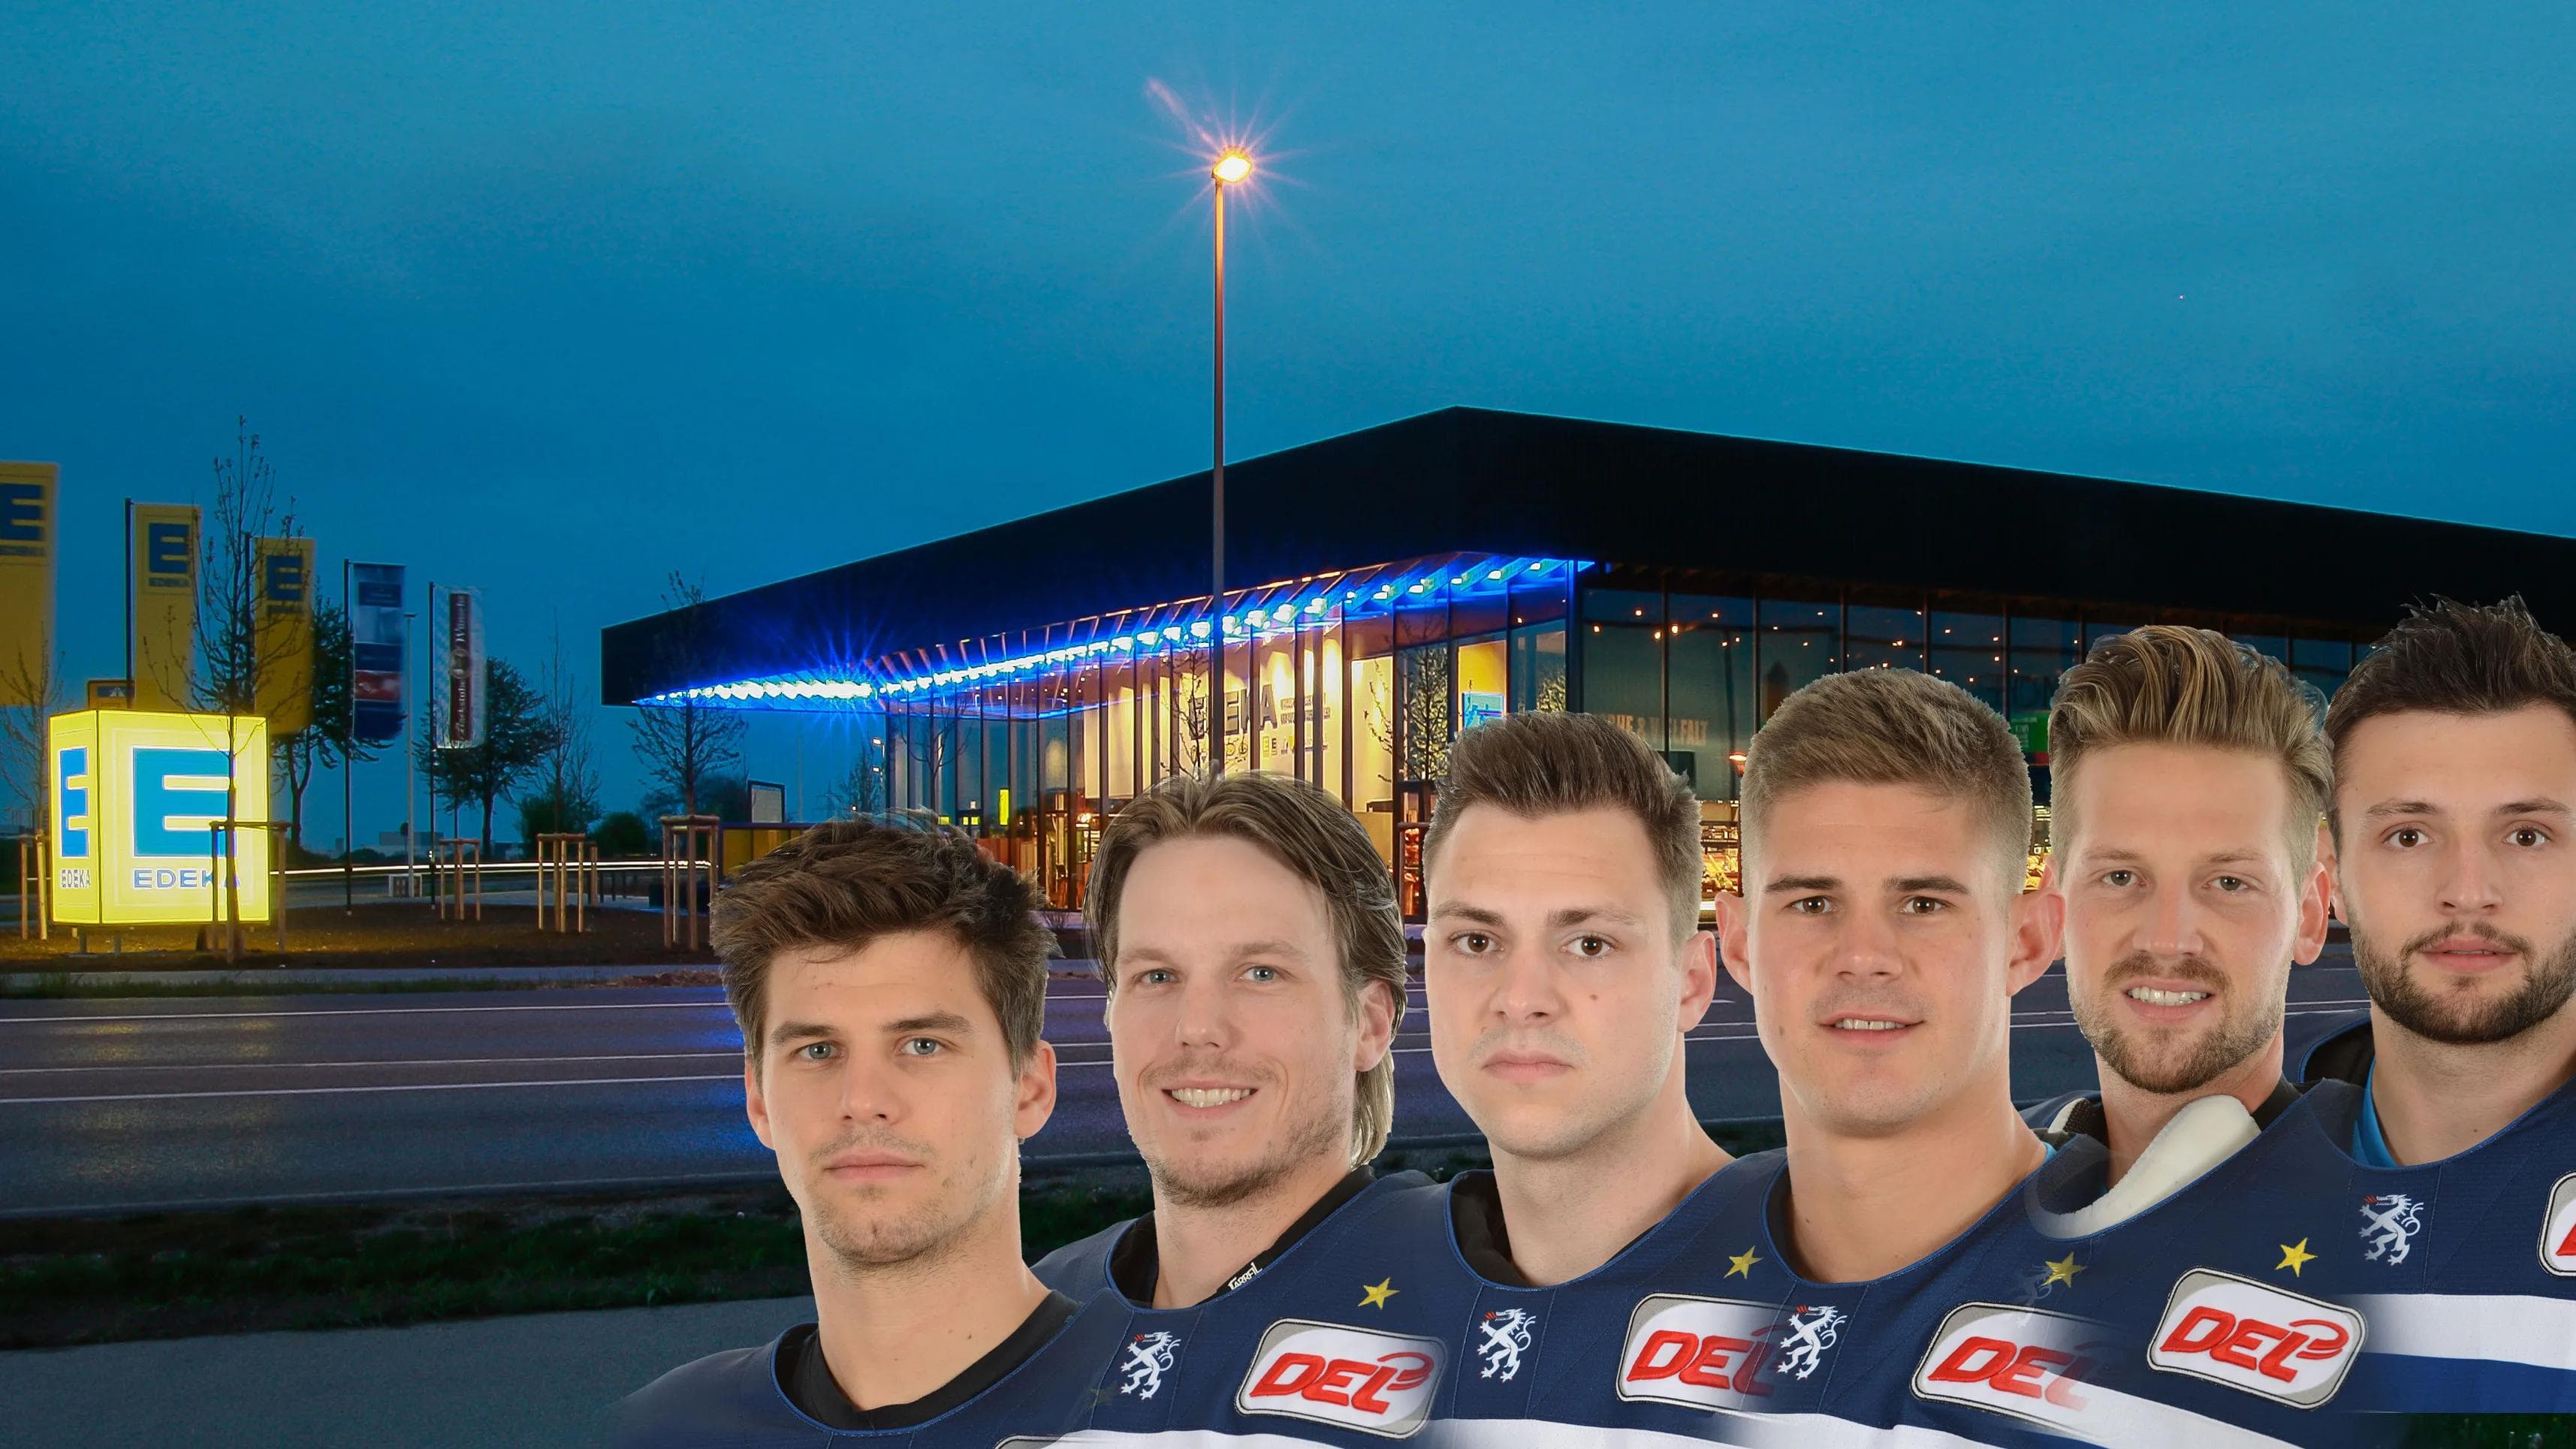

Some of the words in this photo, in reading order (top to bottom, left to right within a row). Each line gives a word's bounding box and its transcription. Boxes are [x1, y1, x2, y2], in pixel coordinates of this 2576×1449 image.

[149, 523, 189, 573] E
[267, 555, 302, 600] E
[59, 747, 89, 857] E
[134, 747, 237, 857] E
[61, 869, 91, 889] EDEKA
